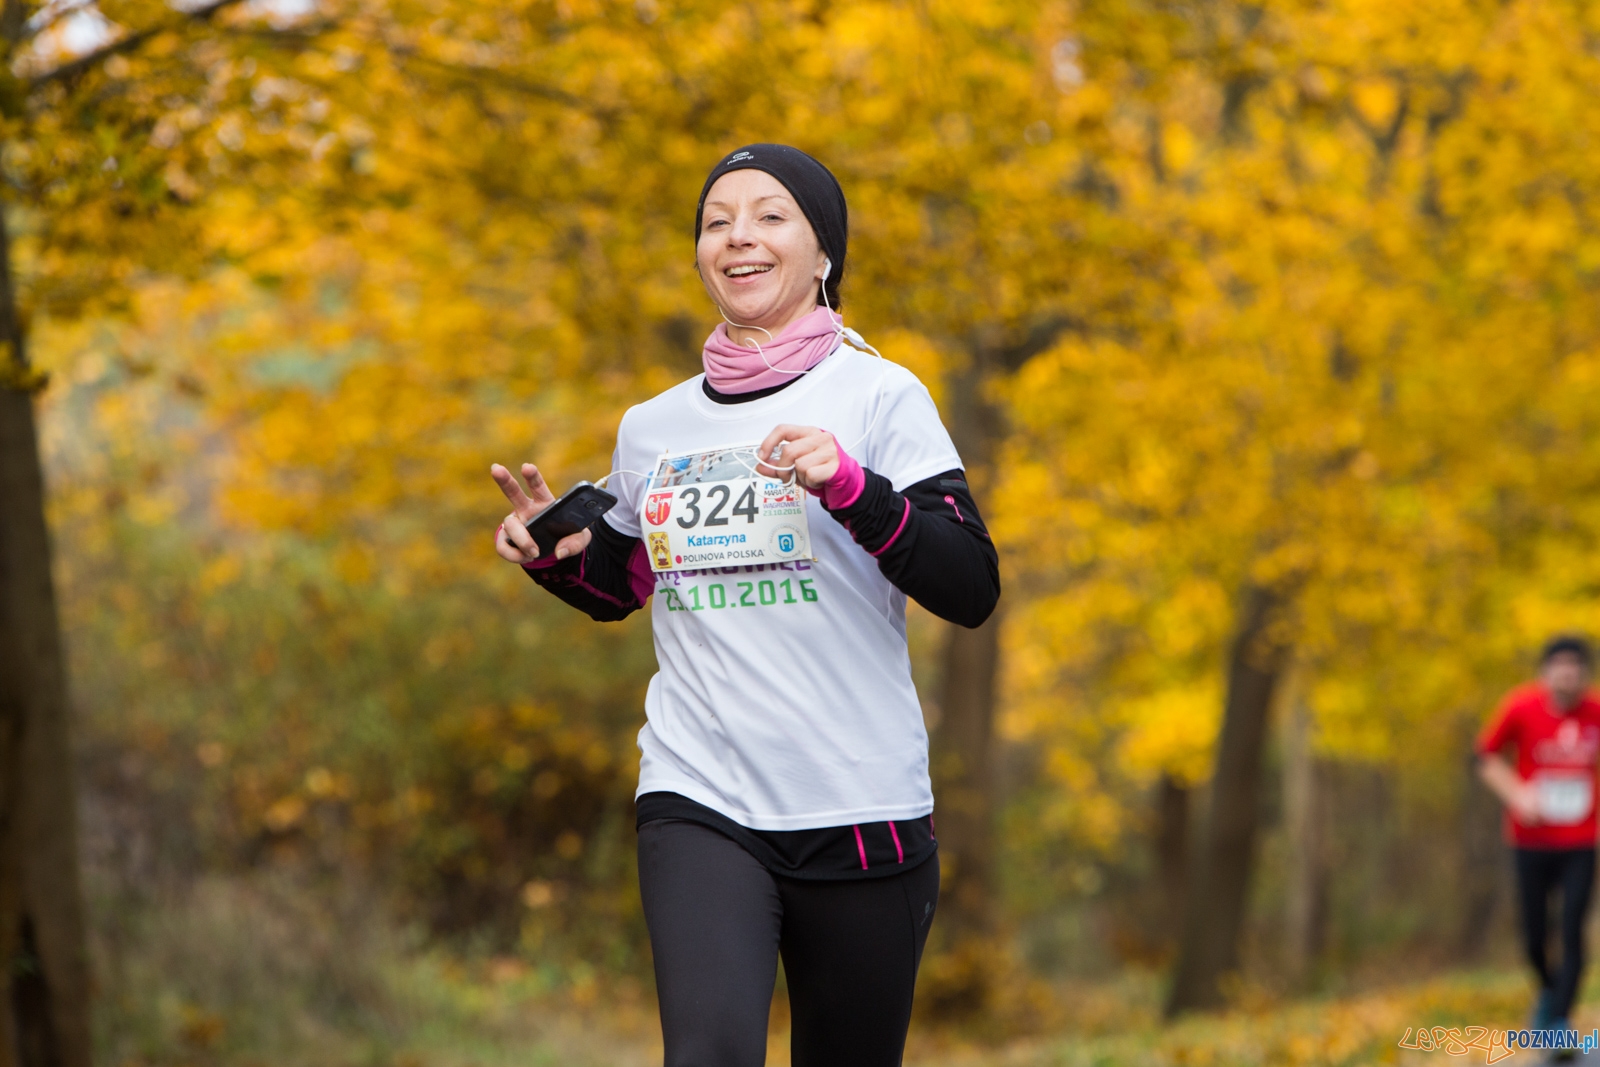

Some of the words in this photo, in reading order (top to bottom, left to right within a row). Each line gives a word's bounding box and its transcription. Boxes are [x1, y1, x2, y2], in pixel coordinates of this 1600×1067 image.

[676, 482, 759, 529] 324
[763, 508, 802, 516] 23.10.2016
[687, 533, 747, 548] Katarzyna
[683, 552, 725, 563] POLINOVA
[727, 549, 765, 559] POLSKA
